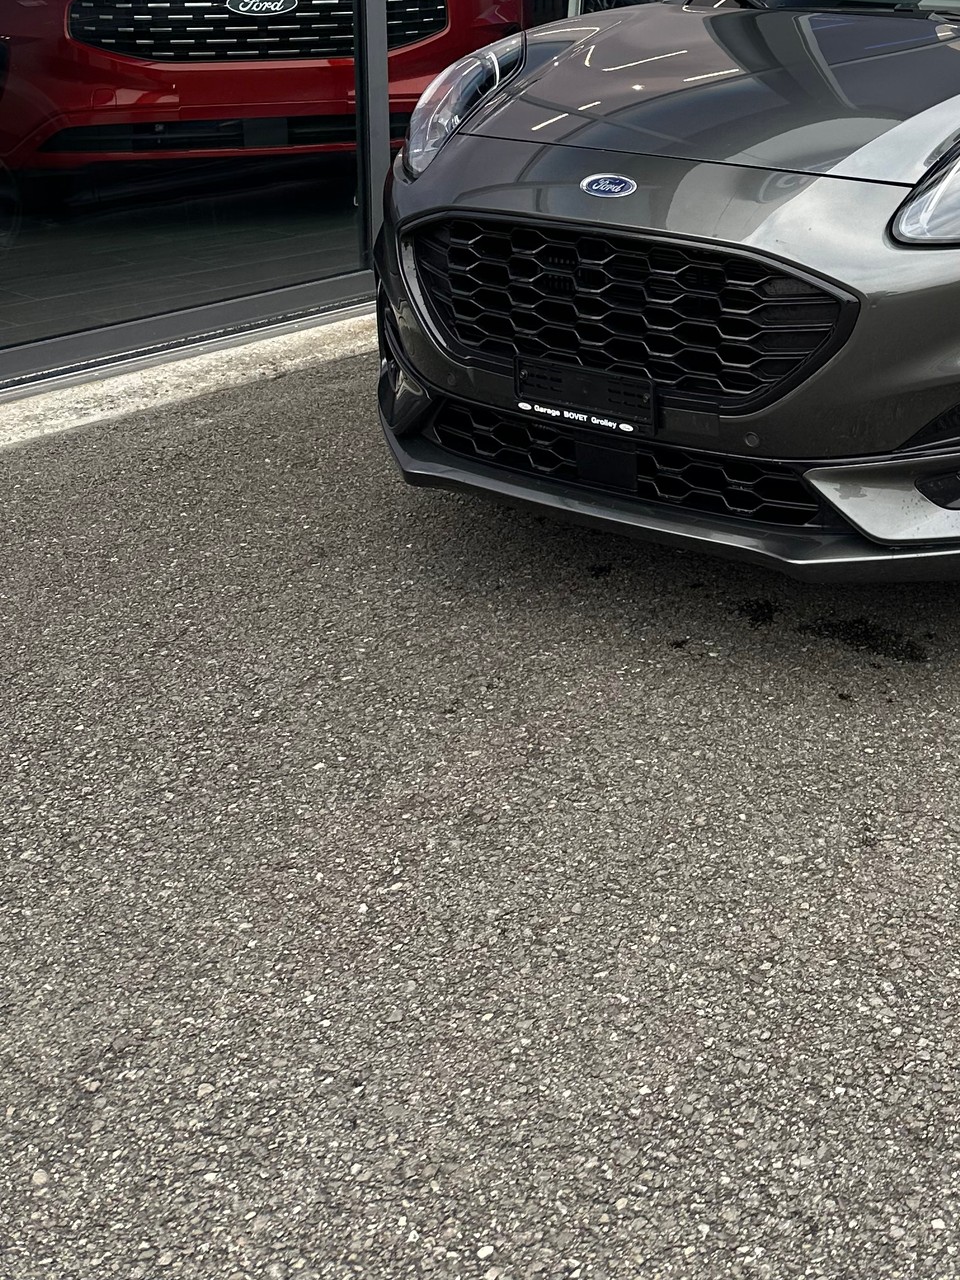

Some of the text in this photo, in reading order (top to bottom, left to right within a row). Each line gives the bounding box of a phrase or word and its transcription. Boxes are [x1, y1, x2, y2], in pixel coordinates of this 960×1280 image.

[591, 178, 626, 193] Ford
[534, 405, 560, 416] Garage
[563, 410, 587, 421] BOVET
